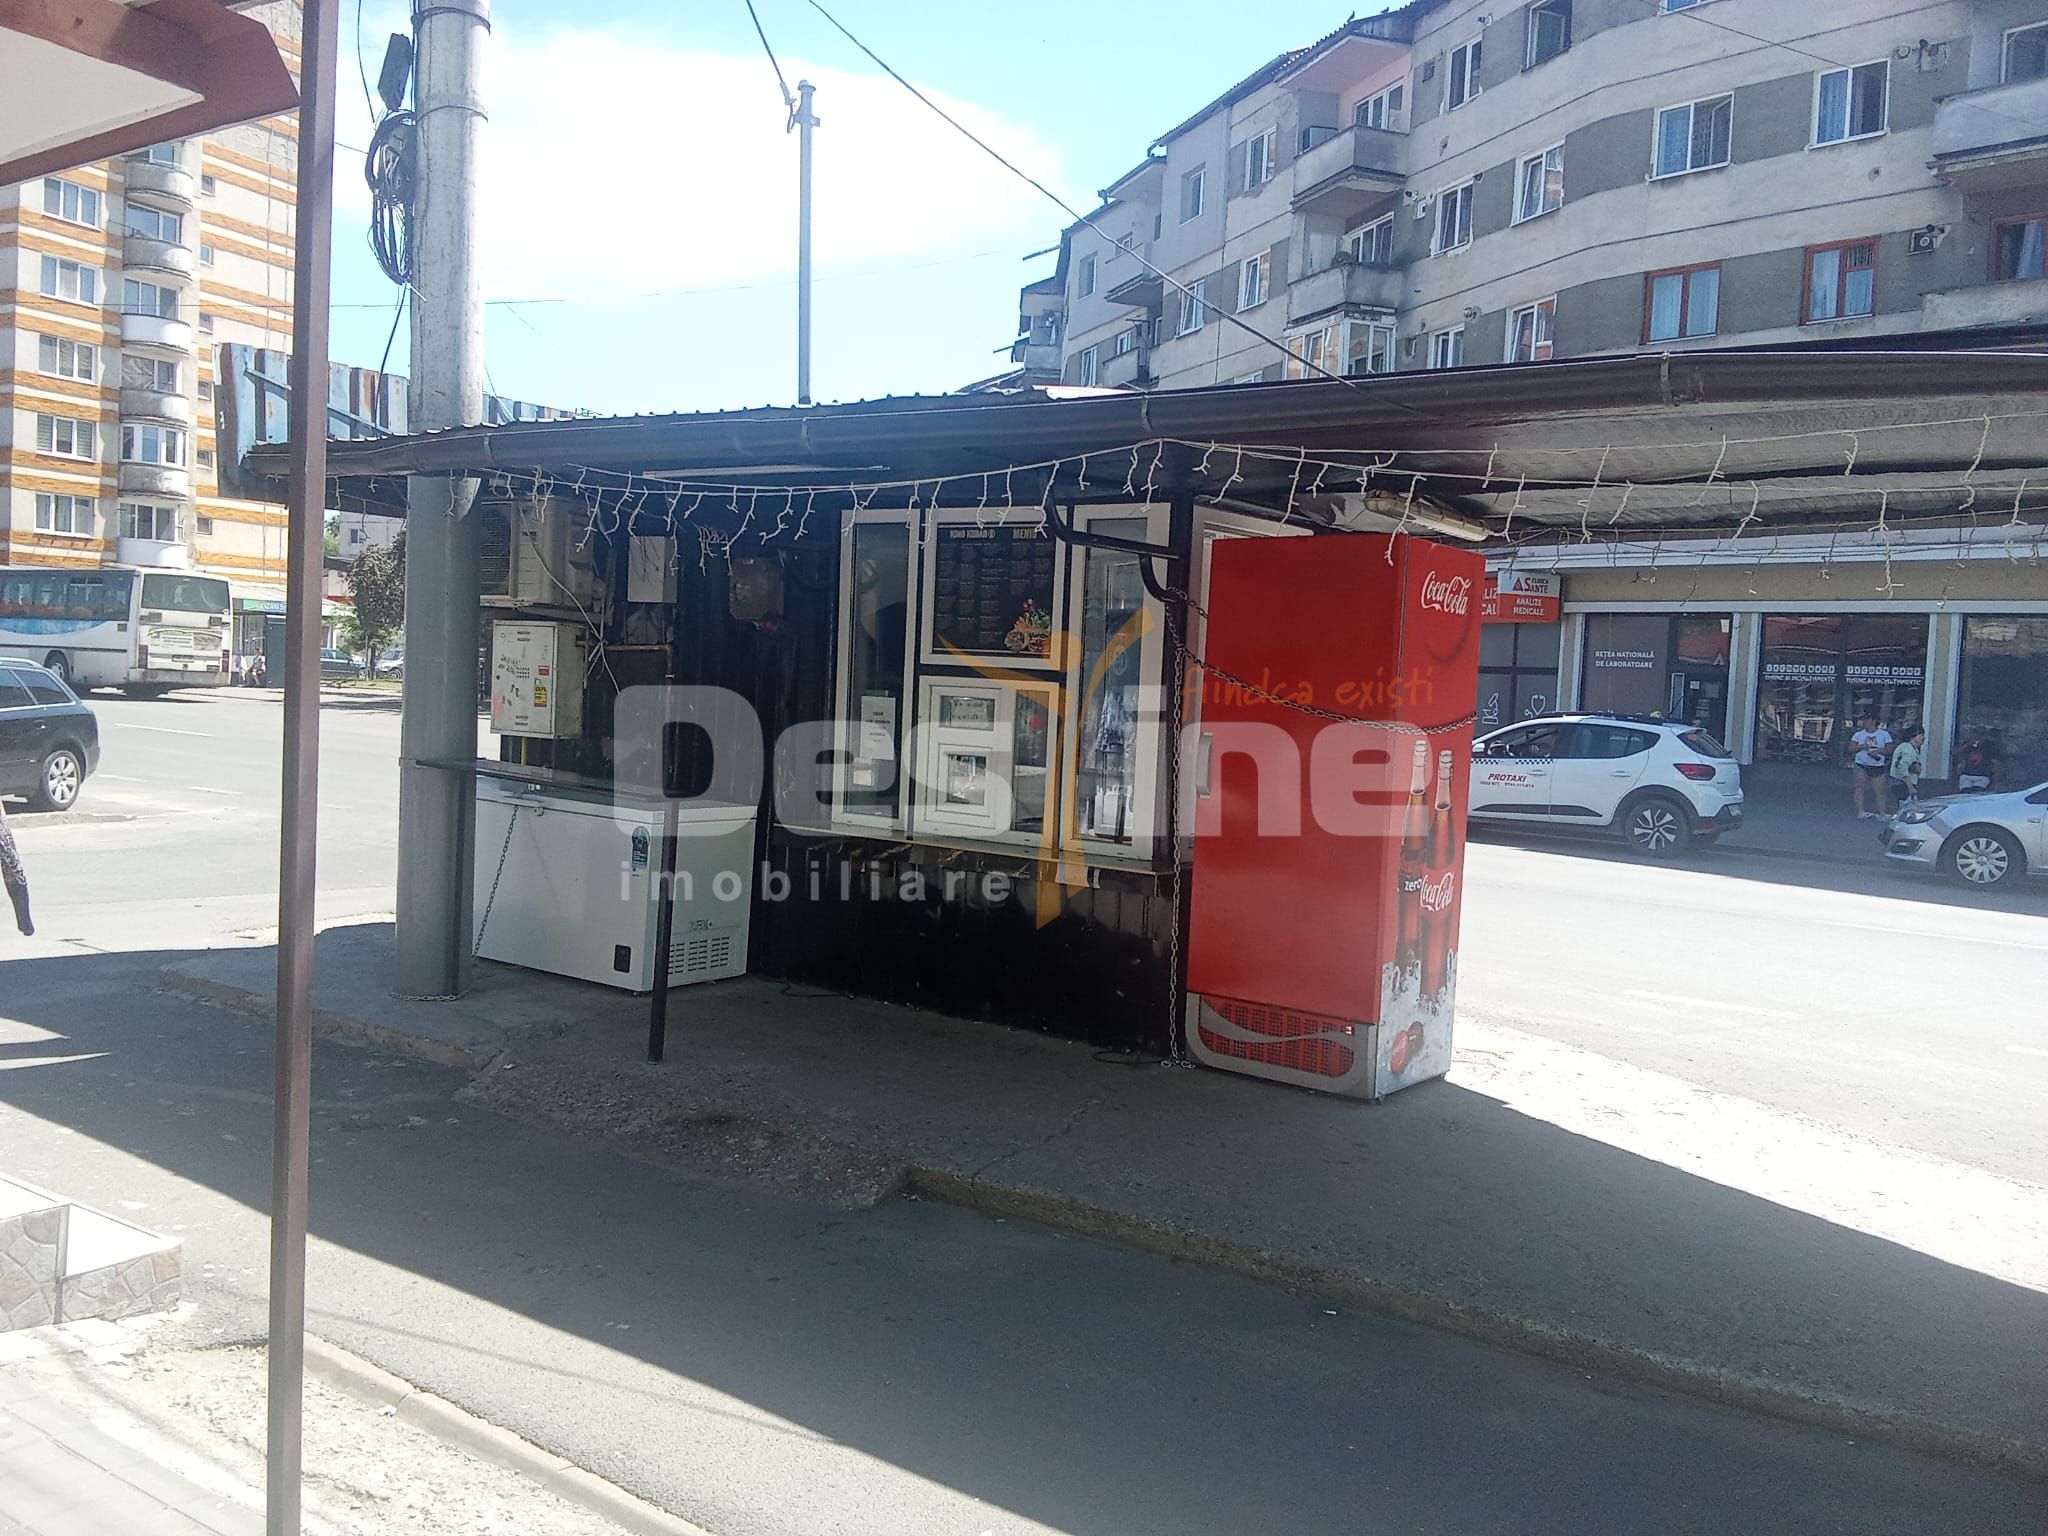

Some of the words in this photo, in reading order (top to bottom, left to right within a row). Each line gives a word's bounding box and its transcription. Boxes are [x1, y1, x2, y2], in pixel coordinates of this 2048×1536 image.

[1516, 597, 1542, 606] ANALIZE
[1513, 606, 1545, 616] MEDICALE
[1605, 660, 1653, 668] LABORATOARE
[1487, 773, 1528, 783] PROTAXI
[1404, 878, 1422, 891] zero
